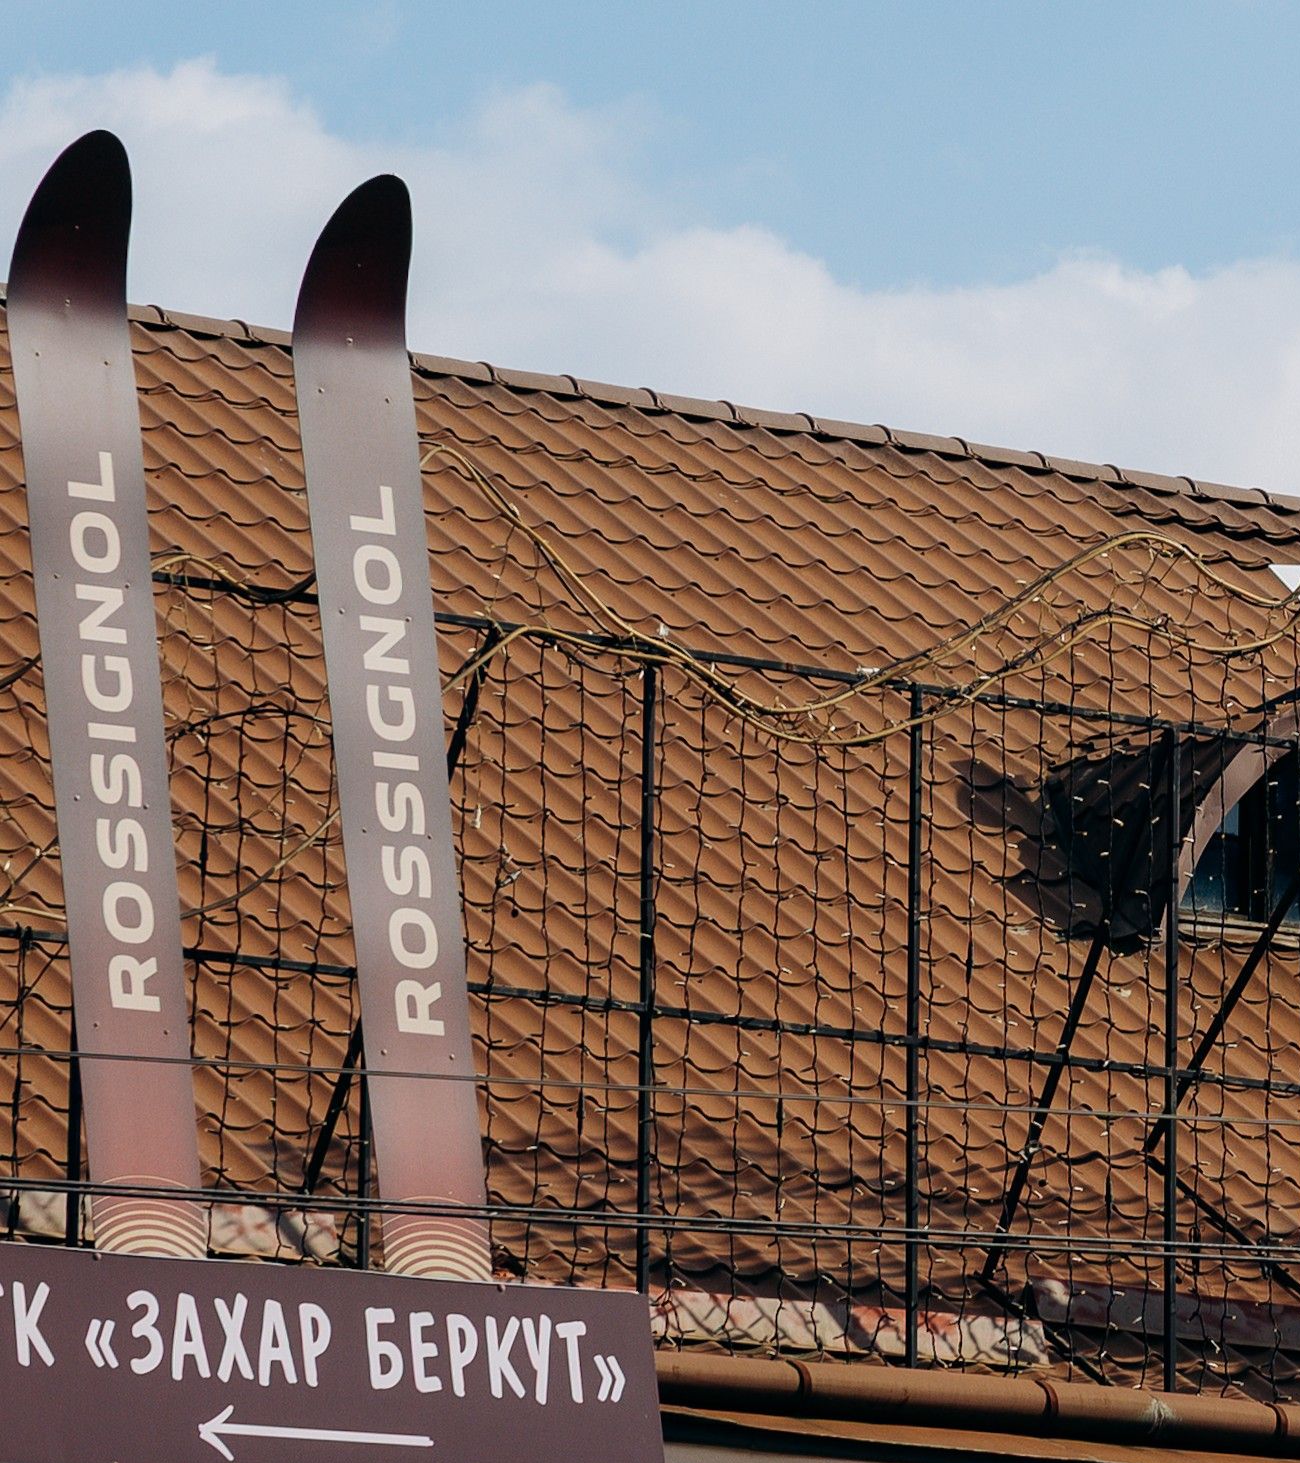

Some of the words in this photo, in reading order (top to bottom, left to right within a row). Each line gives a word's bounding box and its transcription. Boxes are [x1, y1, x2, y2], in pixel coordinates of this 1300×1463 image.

[66, 452, 162, 1013] ROSSIGNOL
[348, 486, 446, 1037] ROSSIGNOL
[84, 1289, 332, 1388] «ЗАХАР
[363, 1305, 627, 1406] БЕРКУТ»
